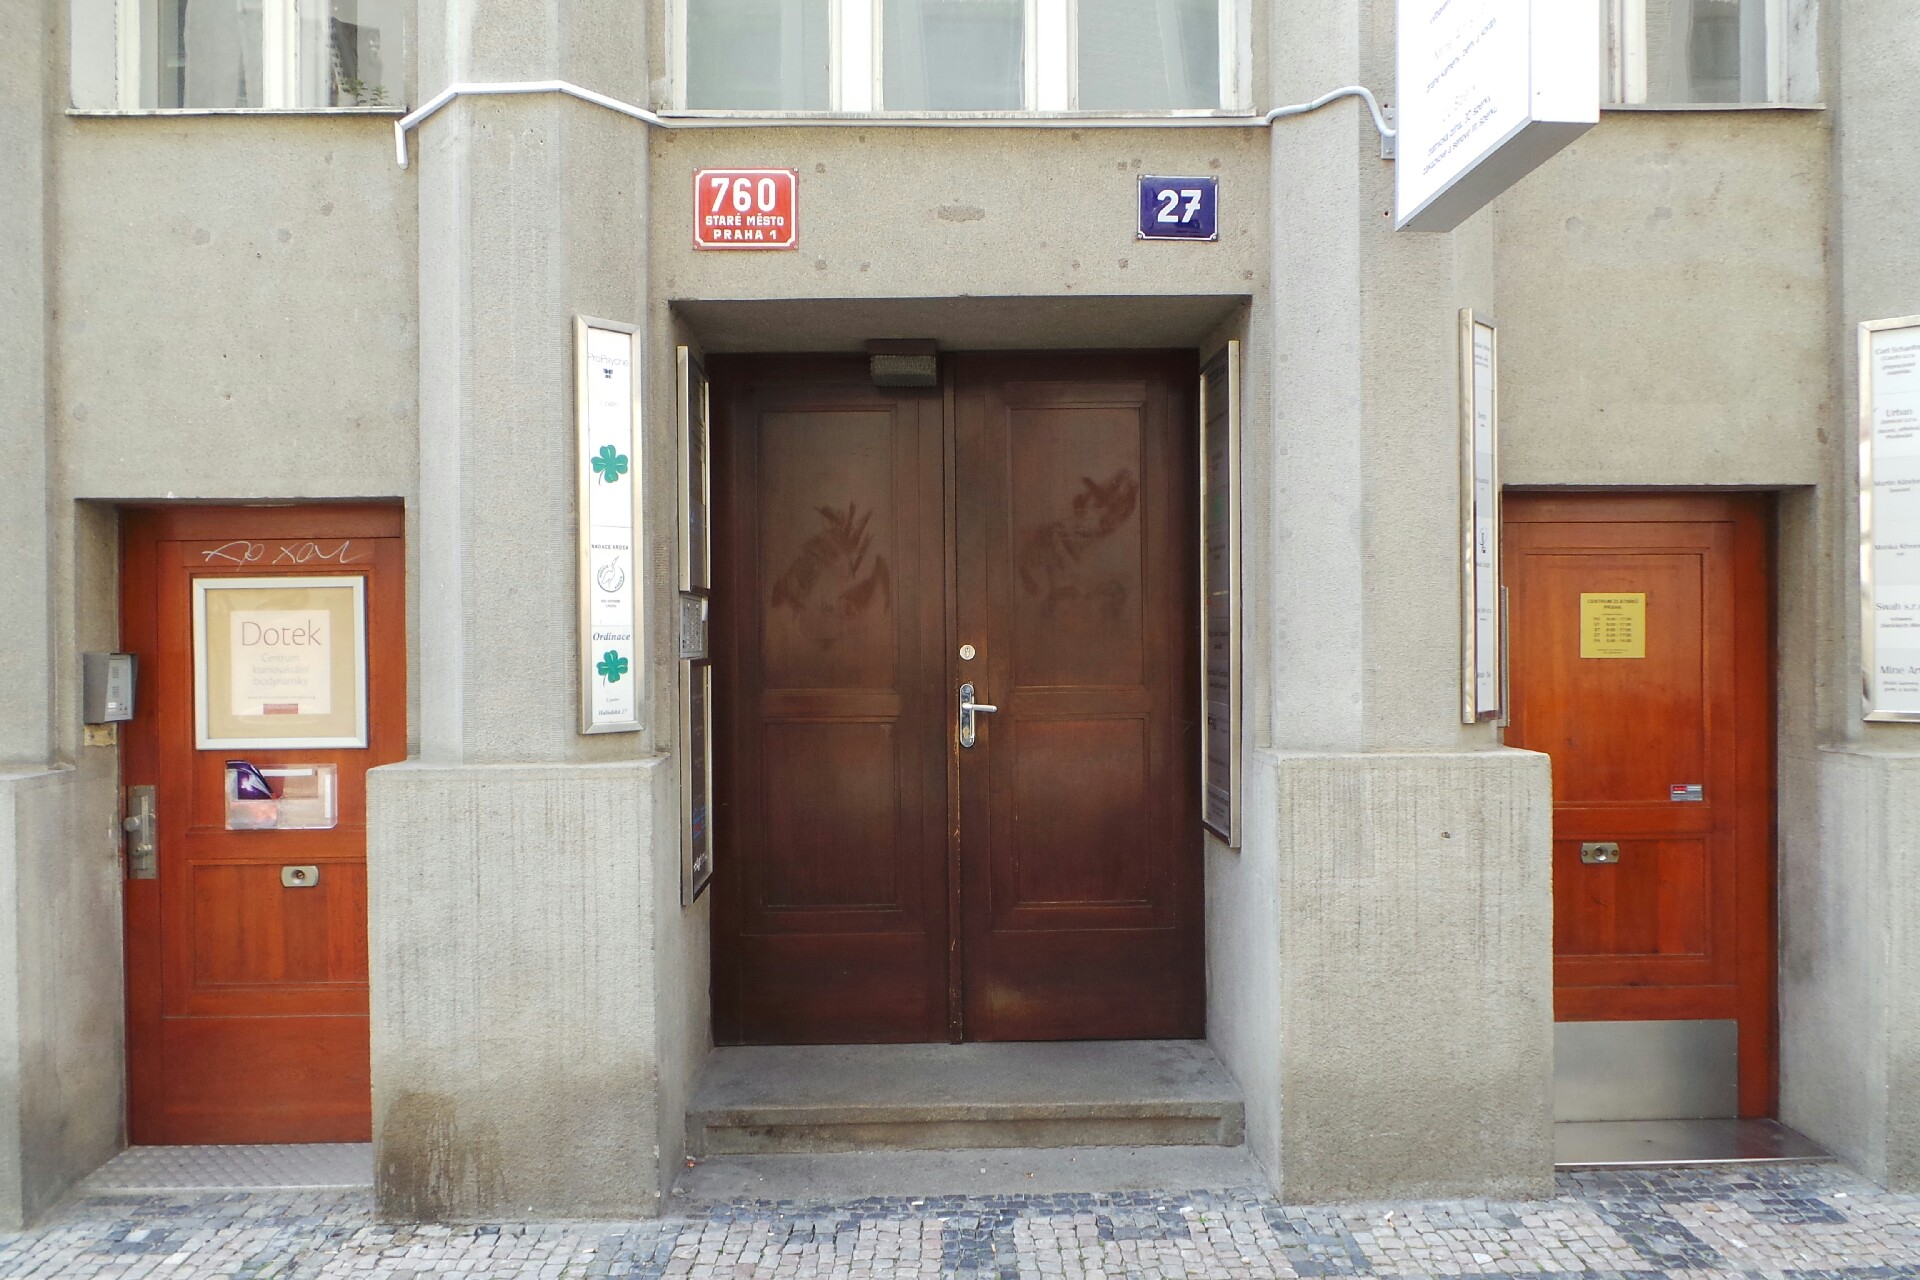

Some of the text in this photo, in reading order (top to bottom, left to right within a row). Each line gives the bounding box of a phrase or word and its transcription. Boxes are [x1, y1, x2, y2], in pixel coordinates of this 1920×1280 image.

[711, 177, 776, 212] 760
[1157, 189, 1202, 223] 27
[705, 213, 785, 227] STARÉ MĚSTO
[713, 229, 777, 240] PRAHA 1
[242, 619, 322, 646] Dotek
[592, 632, 631, 641] Ordinace
[261, 653, 300, 662] Centrum
